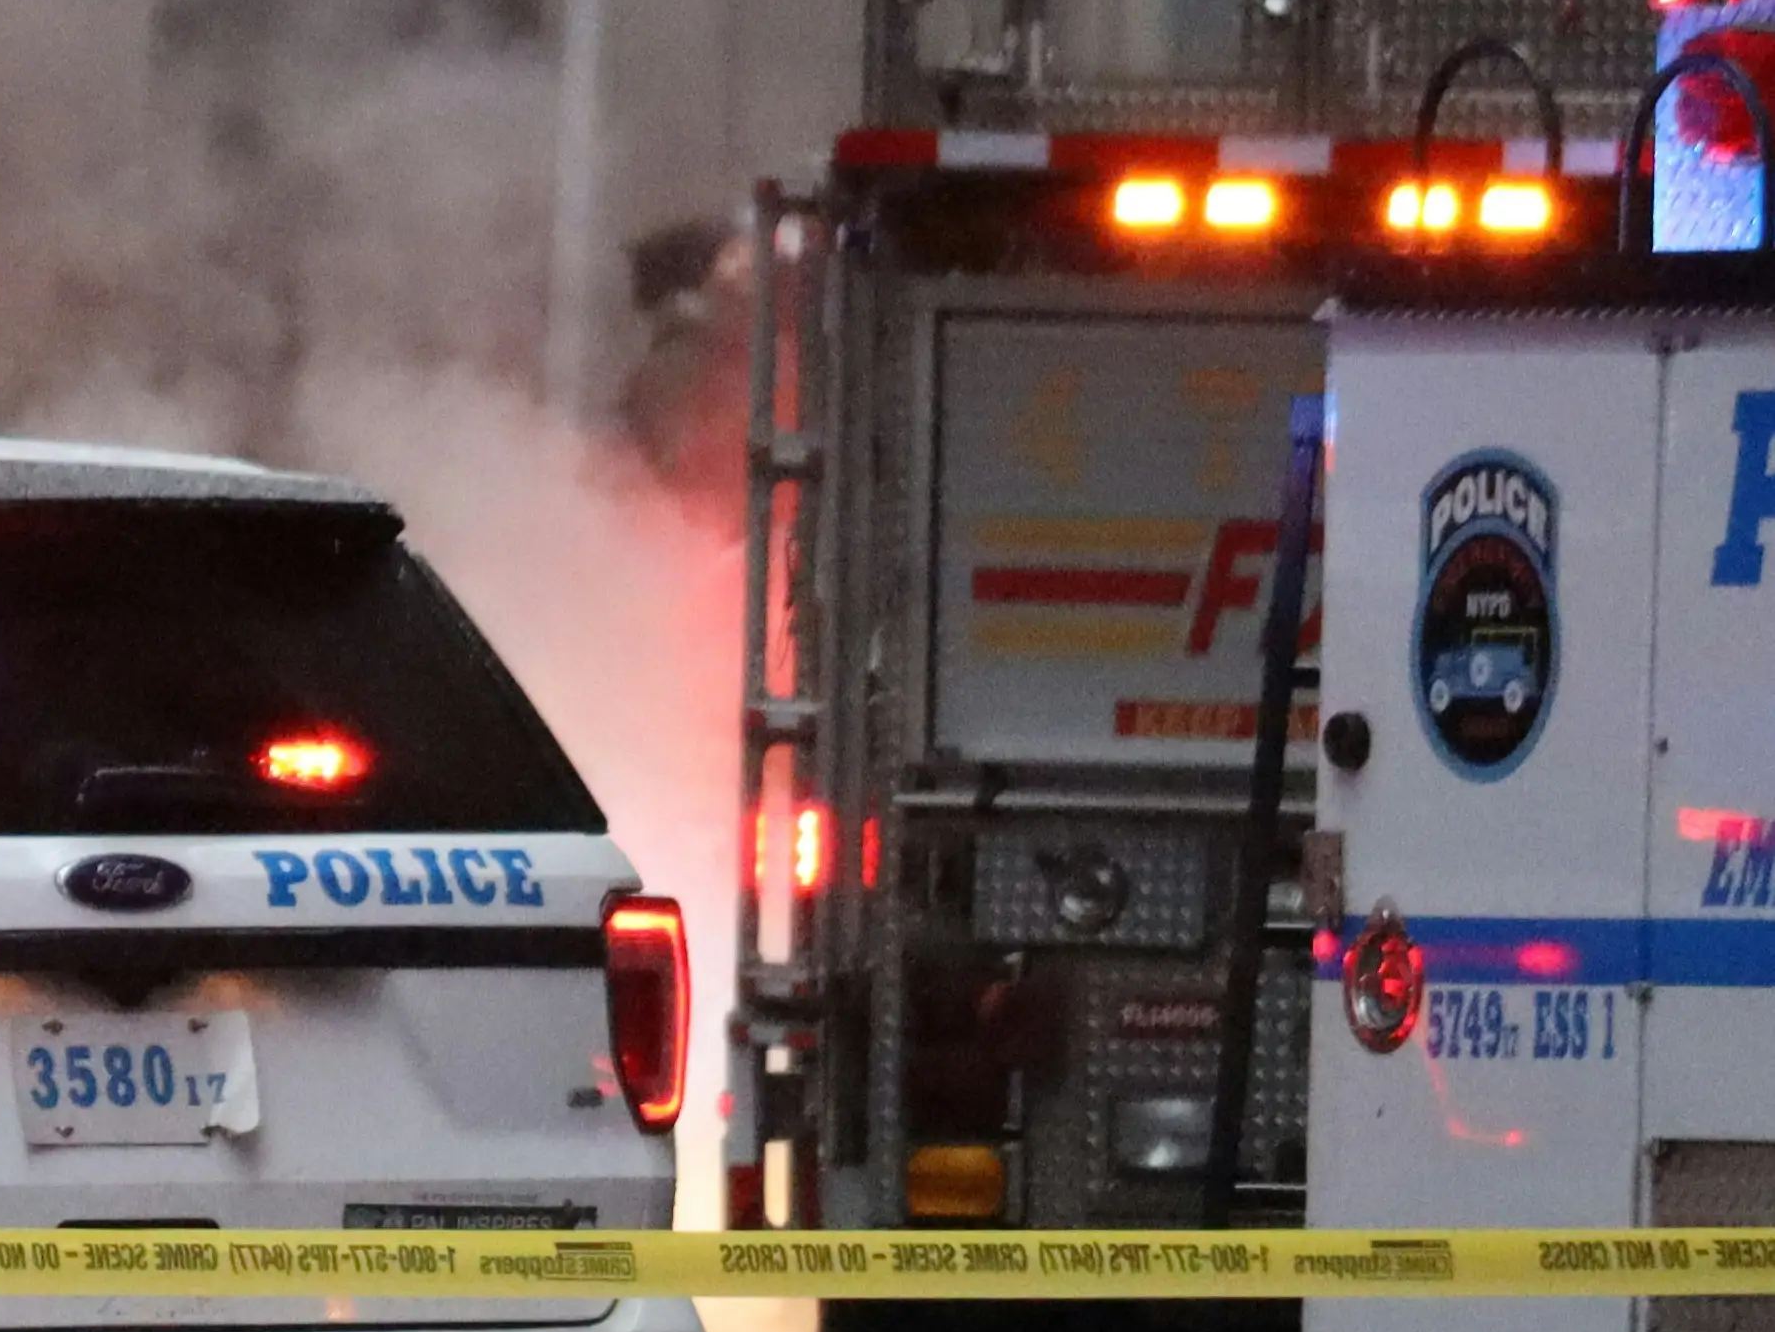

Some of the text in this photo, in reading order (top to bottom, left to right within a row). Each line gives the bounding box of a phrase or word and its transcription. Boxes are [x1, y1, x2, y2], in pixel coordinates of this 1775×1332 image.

[1466, 593, 1511, 618] NYPD
[252, 848, 544, 908] POLICE
[1534, 990, 1588, 1060] ESS
[27, 1044, 174, 1108] 3580
